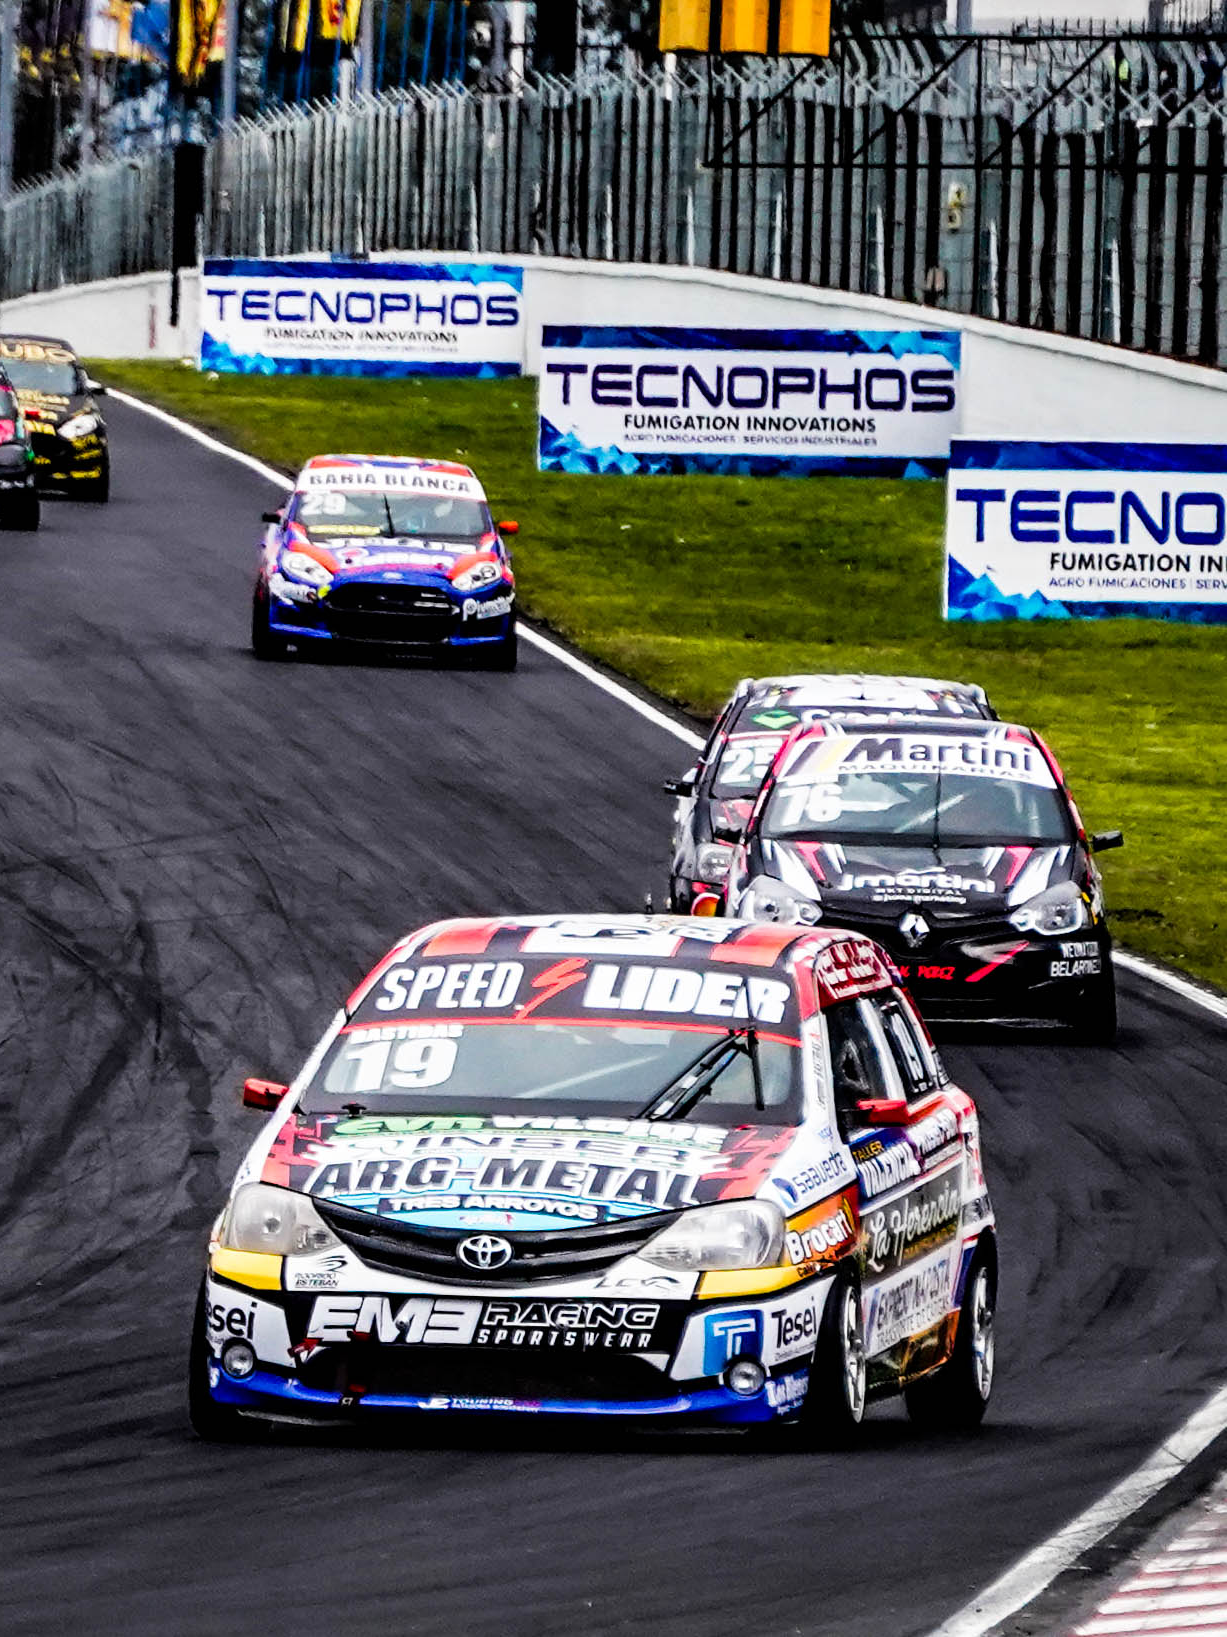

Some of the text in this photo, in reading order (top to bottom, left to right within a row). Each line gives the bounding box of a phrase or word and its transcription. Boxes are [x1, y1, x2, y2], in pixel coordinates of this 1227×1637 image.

[207, 289, 519, 326] TECNOPHOS
[547, 364, 956, 412] TECNOPHOS
[624, 415, 877, 434] FUMIGATION INNOVATIONS
[309, 472, 471, 493] BAHIA BLANCA
[1050, 552, 1191, 573] FUMIGATION
[842, 737, 1033, 772] Martini
[838, 765, 1031, 779] MAQUINARIAS
[375, 961, 525, 1012] SPEED
[582, 963, 792, 1024] LIDER
[346, 1038, 459, 1092] 19
[853, 1140, 885, 1162] TALLER
[308, 1155, 698, 1209] ARG-METAL
[388, 1196, 461, 1211] TRES
[469, 1196, 598, 1220] ARROYOS
[482, 1301, 660, 1330] RACING
[772, 1296, 817, 1349] Tesei
[476, 1328, 652, 1348] SPORTSWEAR
